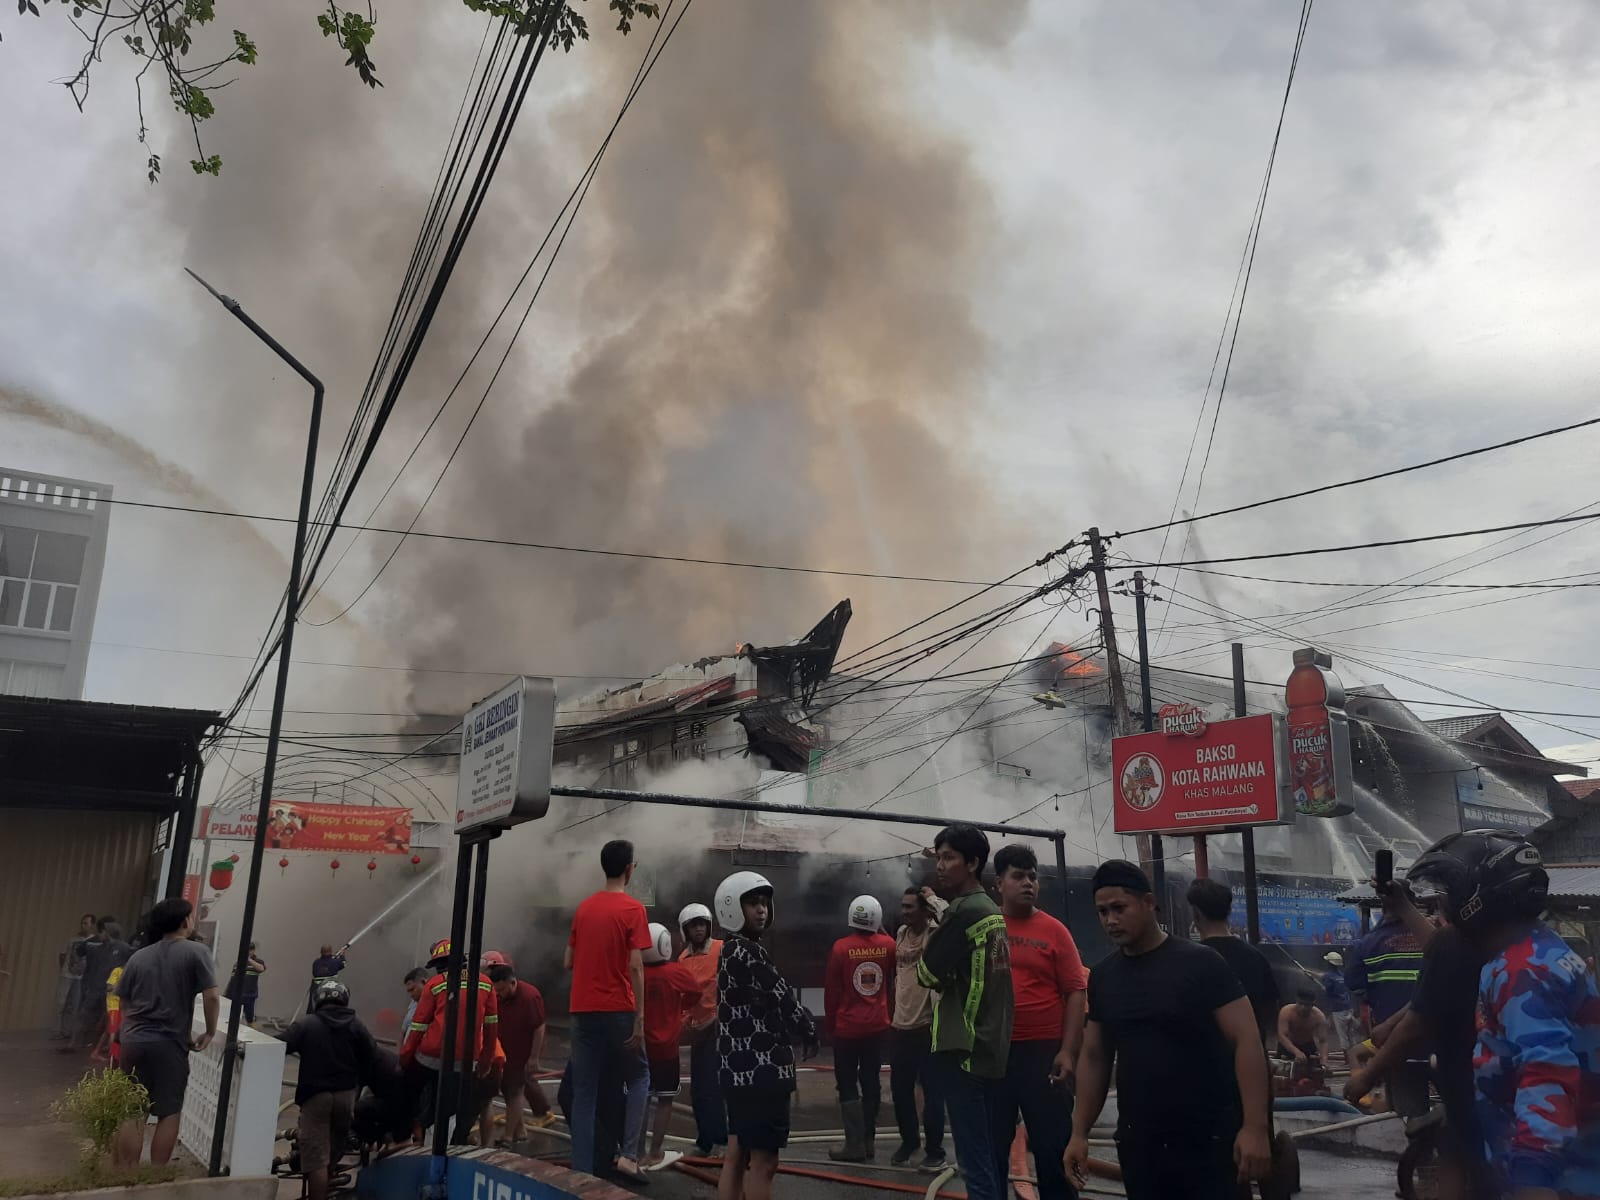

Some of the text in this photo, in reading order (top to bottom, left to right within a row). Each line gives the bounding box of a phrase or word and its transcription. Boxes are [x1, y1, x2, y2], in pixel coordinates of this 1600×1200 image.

[486, 690, 519, 728] BERINGIN
[1170, 723, 1198, 733] HARUM
[1196, 744, 1236, 763] BAKSO
[1299, 745, 1325, 754] HARUM
[1171, 760, 1266, 786] KOTA RAHWANA
[1184, 783, 1254, 800] KHAS MALANG
[308, 814, 386, 827] Happy Chinese
[323, 831, 370, 842] New Year
